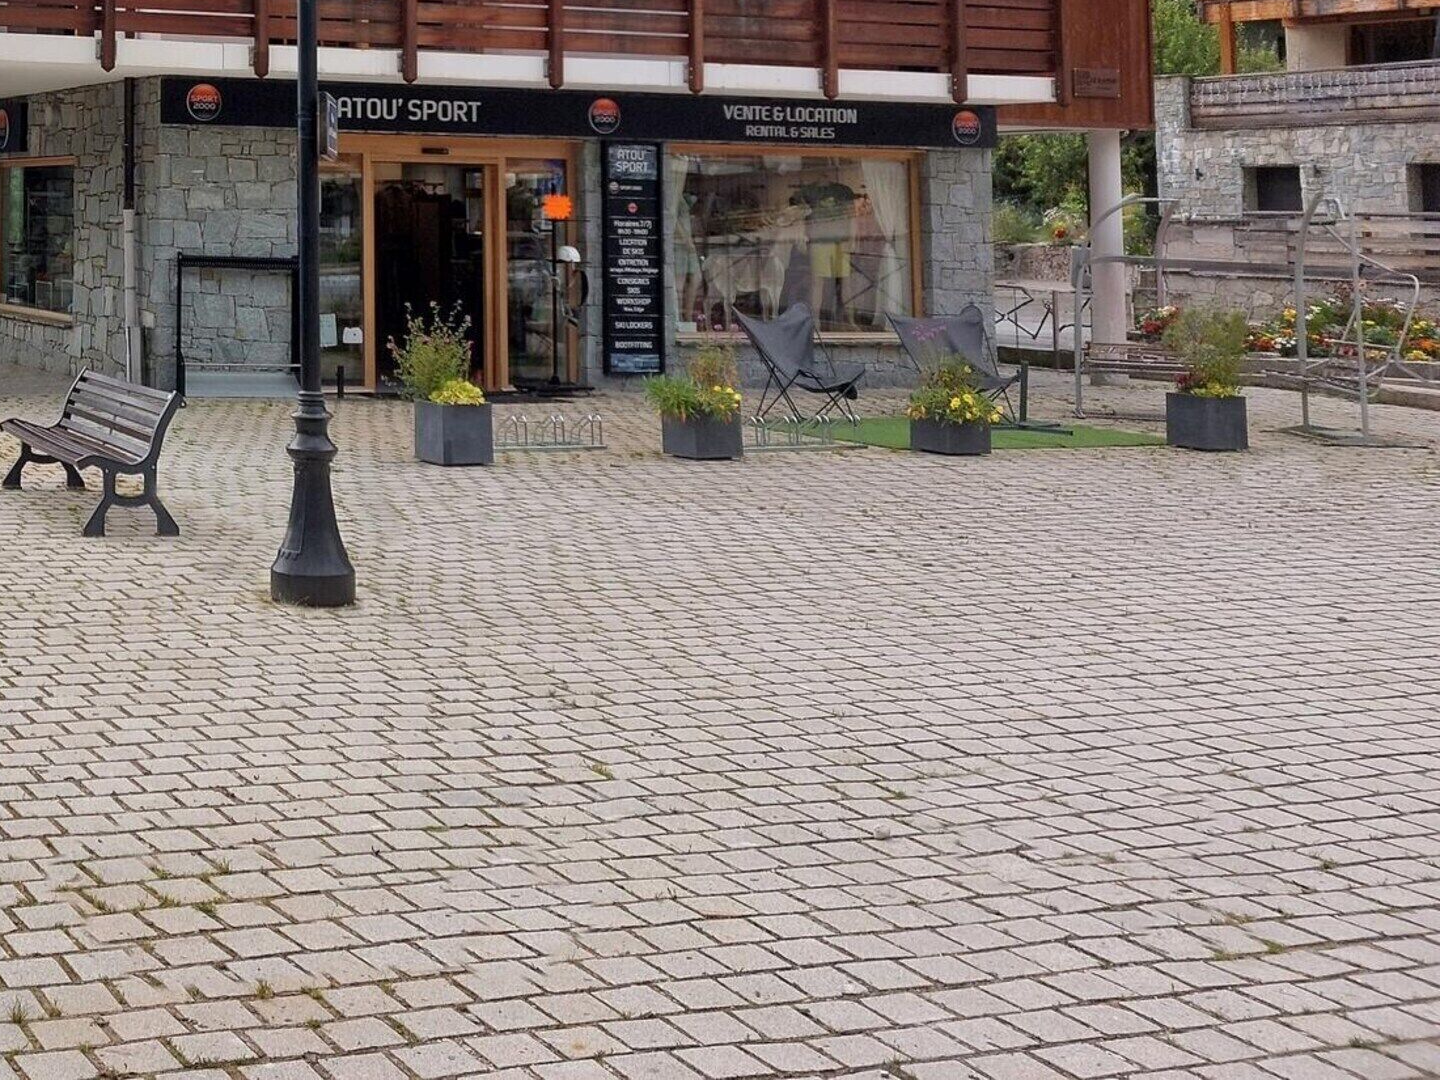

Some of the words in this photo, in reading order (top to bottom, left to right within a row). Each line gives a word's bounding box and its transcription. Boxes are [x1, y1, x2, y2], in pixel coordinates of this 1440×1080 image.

[190, 94, 218, 103] SPORT
[193, 102, 216, 110] 2000
[337, 97, 403, 120] ATOU'
[408, 99, 482, 123] SPORT
[594, 115, 615, 123] 2000
[723, 104, 771, 121] VENTE
[773, 106, 785, 121] &
[786, 106, 857, 124] LOCATION
[745, 125, 789, 138] RENTAL
[790, 126, 799, 138] &
[800, 126, 835, 139] SALES
[615, 160, 648, 172] SPORT
